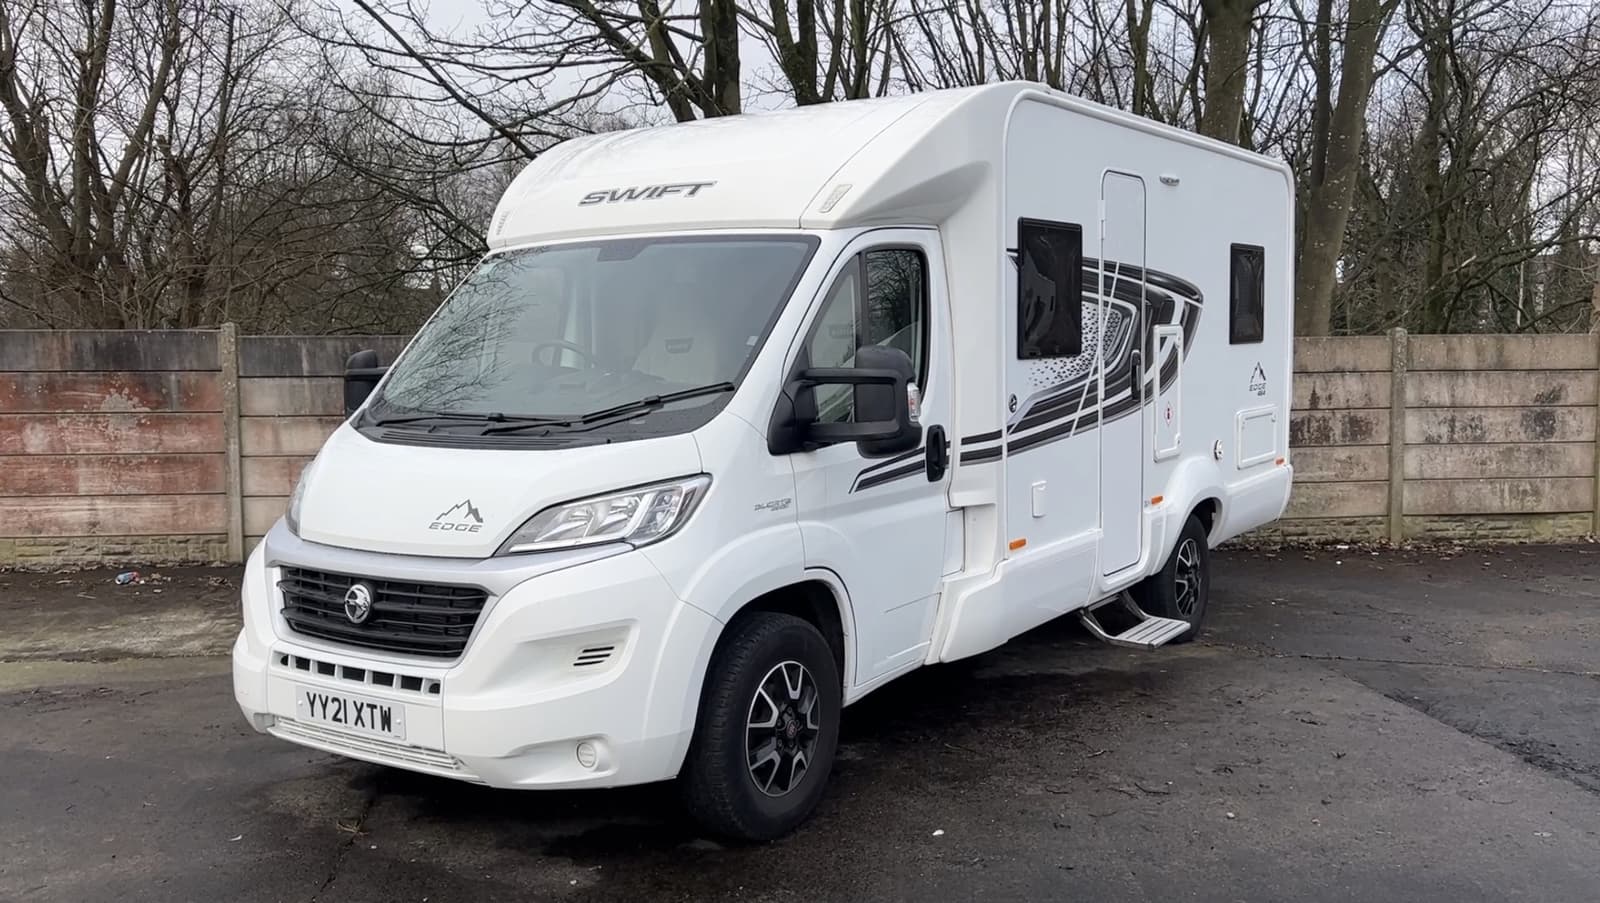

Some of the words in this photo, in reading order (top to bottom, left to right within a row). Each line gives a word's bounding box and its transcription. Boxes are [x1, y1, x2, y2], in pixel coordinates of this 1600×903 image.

[577, 180, 717, 206] SWIFT
[428, 521, 482, 532] EDGE
[306, 691, 348, 725] YY21
[352, 700, 392, 733] XTW
